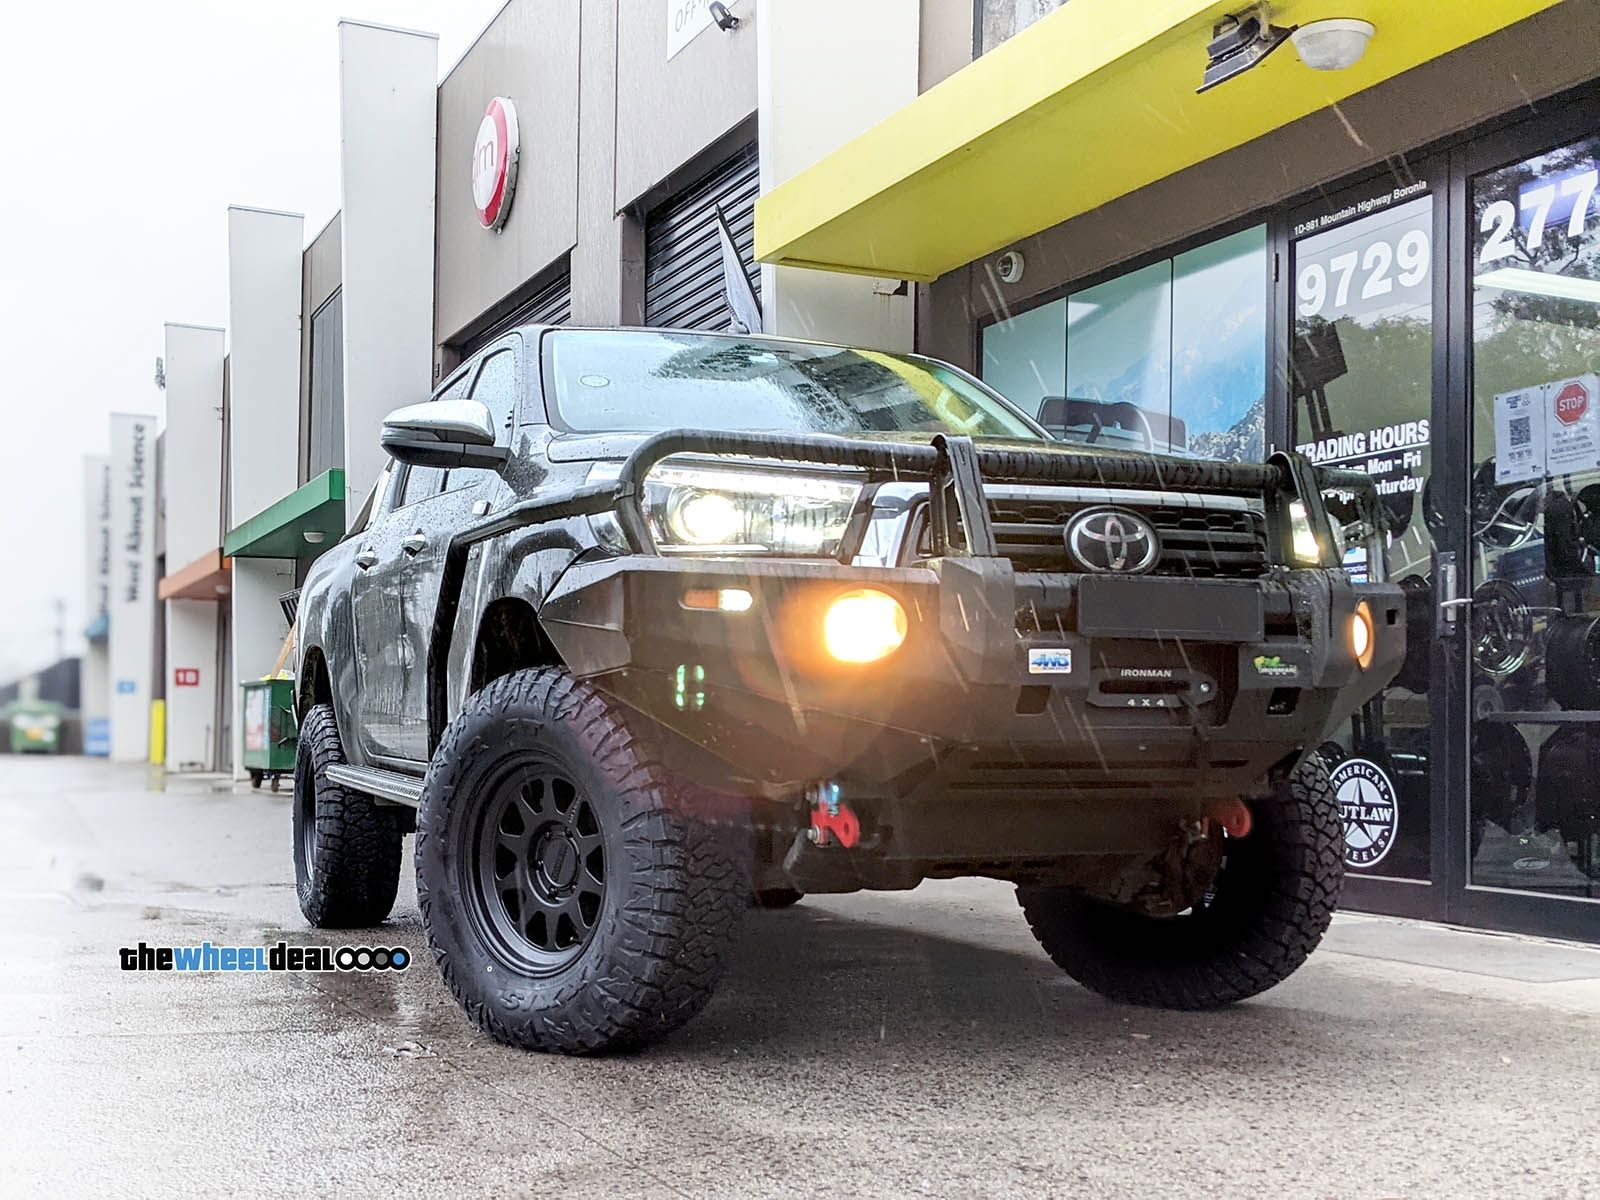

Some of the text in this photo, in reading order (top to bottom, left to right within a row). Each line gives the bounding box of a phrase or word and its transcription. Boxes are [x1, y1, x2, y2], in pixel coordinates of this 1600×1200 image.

[1320, 206, 1356, 226] Mountain
[1357, 193, 1392, 213] Highway
[1393, 180, 1427, 200] Boronia
[1479, 169, 1599, 264] 277
[1297, 229, 1430, 317] 9729
[1559, 395, 1584, 412] STOP
[1369, 419, 1430, 450] HOURS
[128, 423, 145, 489] Science
[1367, 458, 1393, 475] Mon
[1403, 451, 1422, 469] Fri
[1375, 475, 1424, 496] aturday
[1120, 669, 1172, 678] IRONMAN
[1333, 765, 1387, 792] AMERICAN
[1338, 804, 1393, 822] UTLAW
